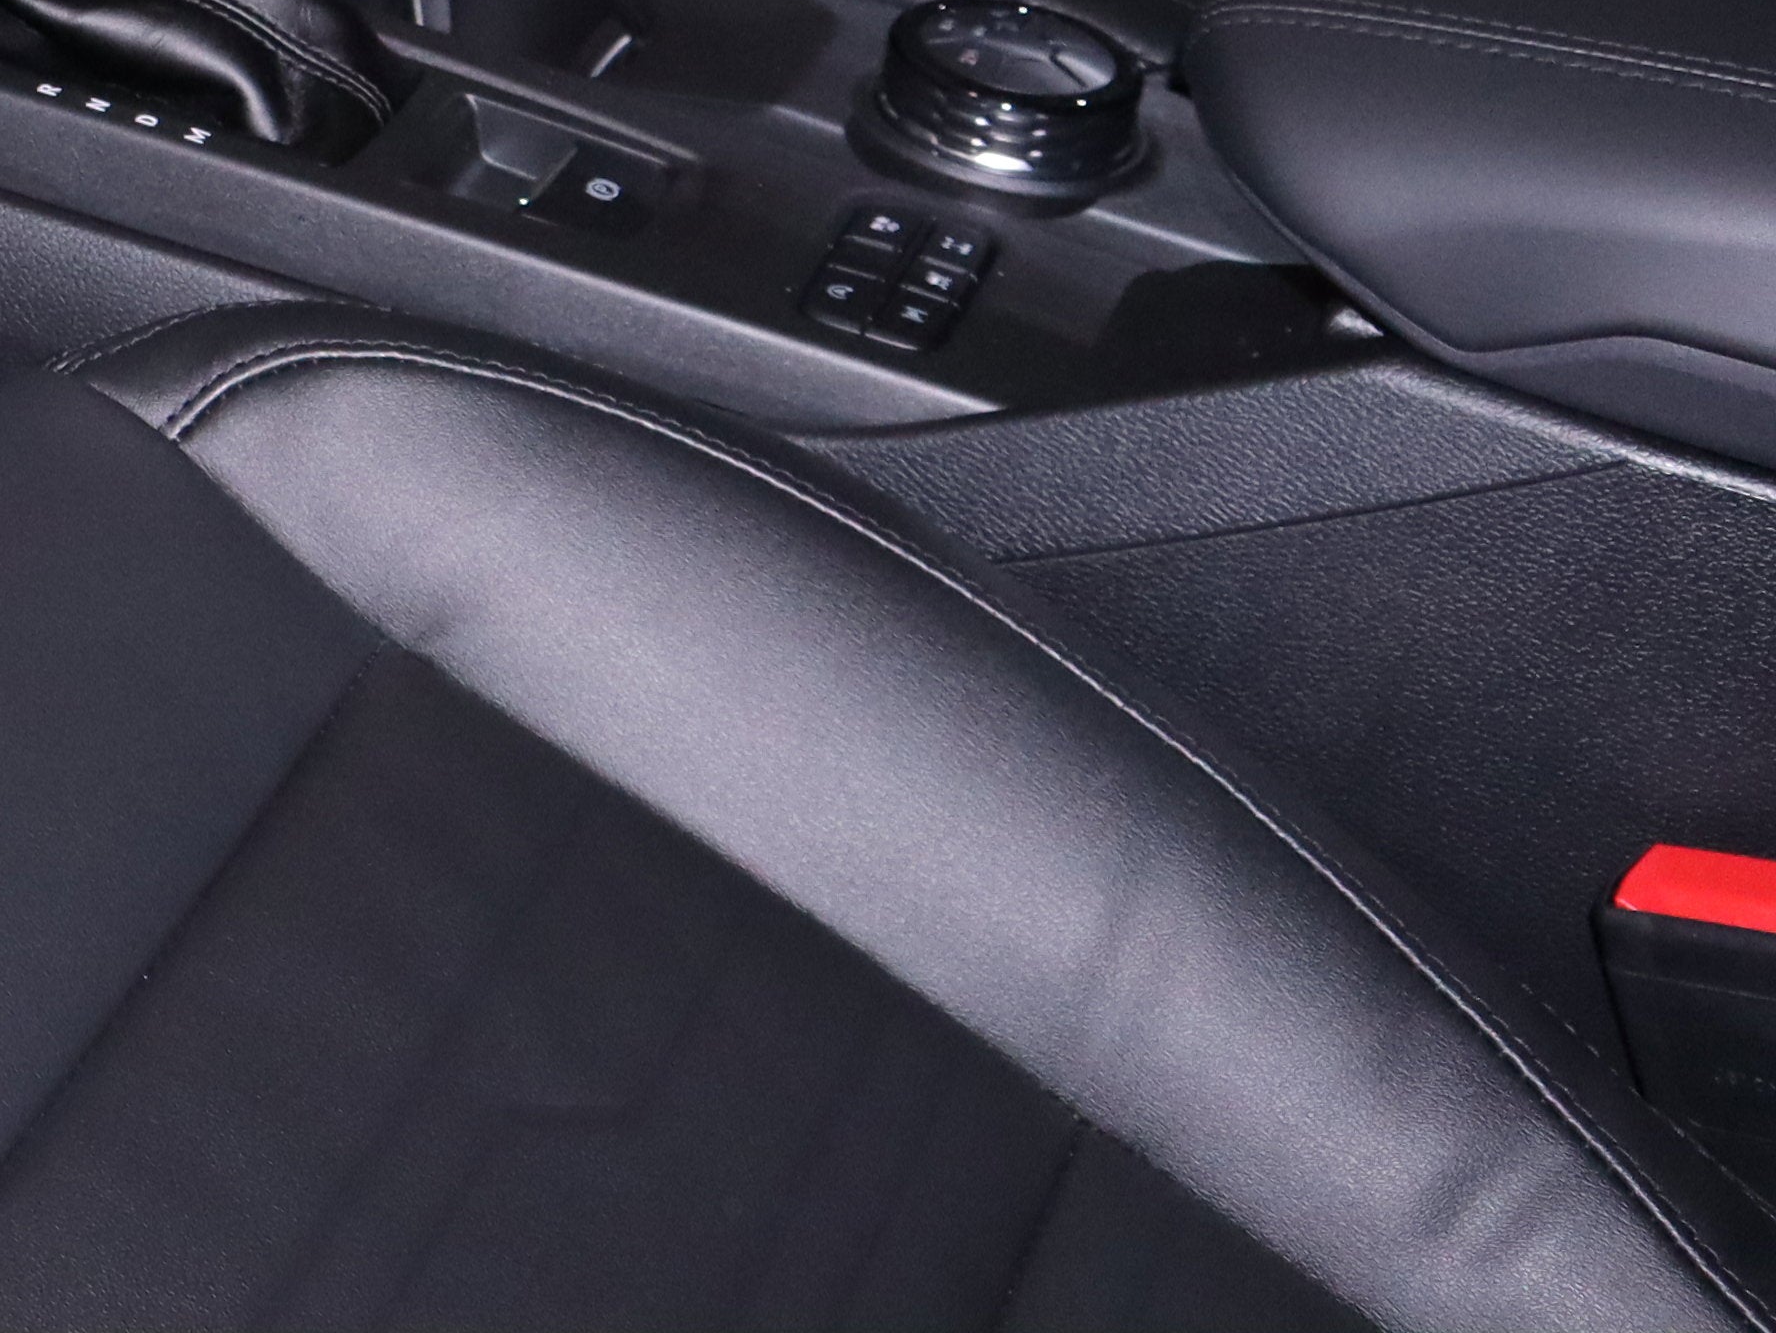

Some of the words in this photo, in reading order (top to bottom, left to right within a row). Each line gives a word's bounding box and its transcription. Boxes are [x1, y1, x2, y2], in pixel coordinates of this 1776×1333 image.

[36, 83, 63, 97] R
[85, 97, 111, 113] N
[134, 114, 159, 128] D
[183, 126, 212, 145] M
